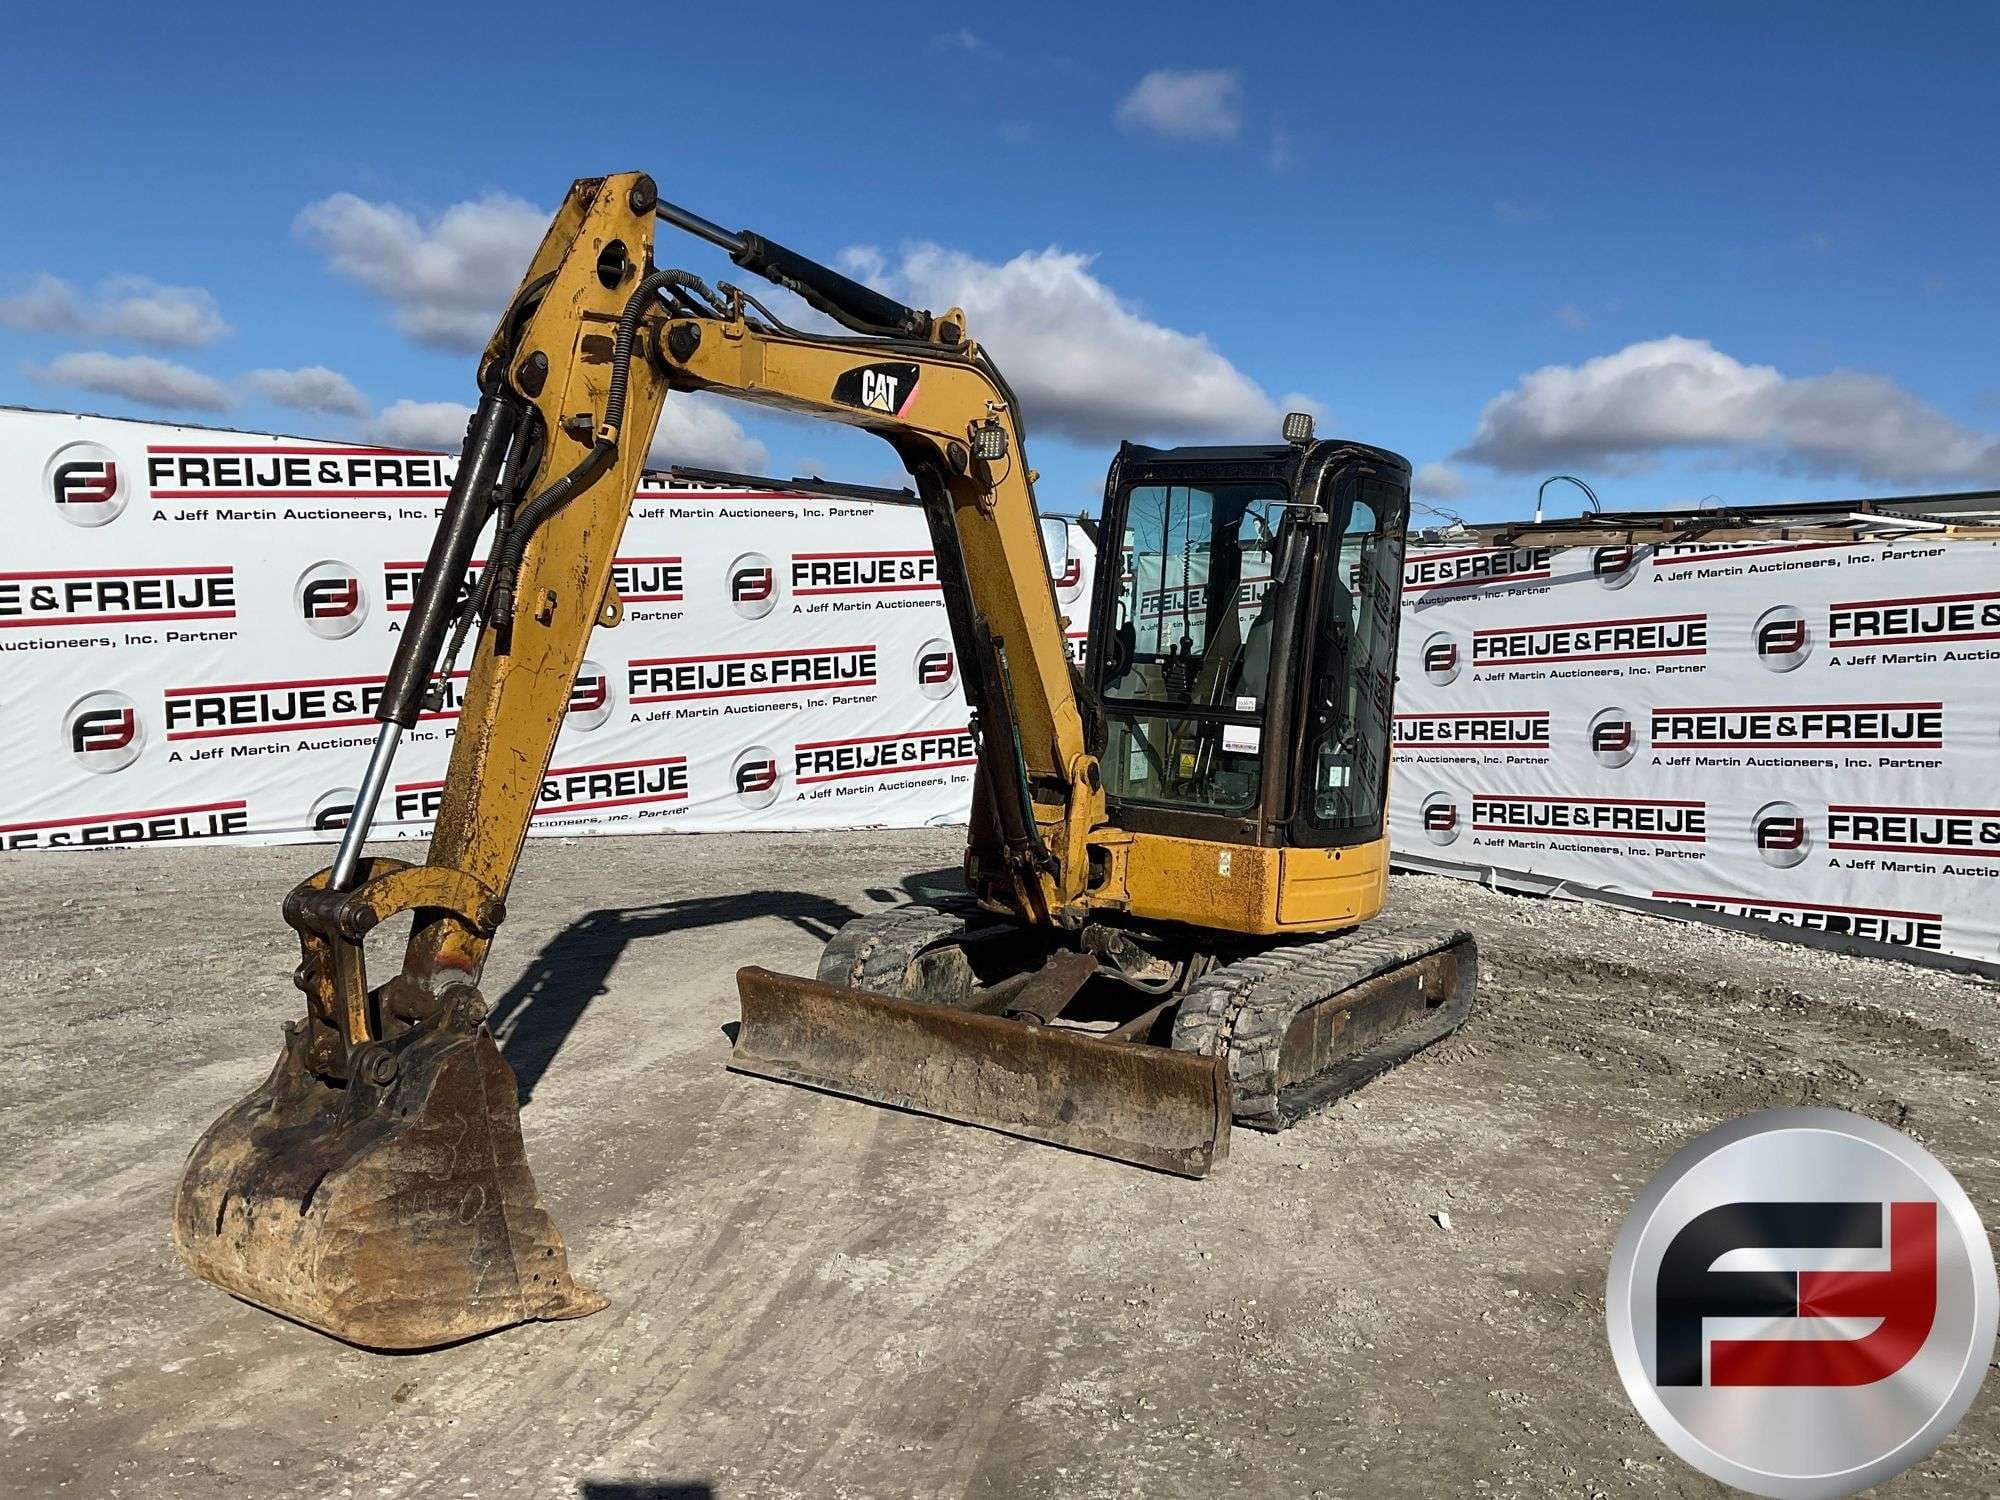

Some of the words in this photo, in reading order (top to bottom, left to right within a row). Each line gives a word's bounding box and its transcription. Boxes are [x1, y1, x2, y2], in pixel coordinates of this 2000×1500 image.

[862, 369, 898, 413] CAT
[153, 511, 167, 521] A
[175, 509, 209, 521] Jeff
[216, 509, 276, 520] Martin
[284, 508, 392, 520] Auctioneers,
[399, 508, 427, 519] Inc.
[639, 508, 665, 518] Jeff
[670, 508, 714, 518] Martin
[719, 507, 798, 519] Auctioneers,
[803, 508, 825, 517] Inc.
[830, 507, 874, 517] Partner
[1653, 574, 1663, 583] A
[1668, 571, 1693, 581] Jeff
[1697, 568, 1742, 579] Martin
[1748, 558, 1841, 573] Auctioneers,
[1848, 555, 1874, 564] Inc.
[1882, 549, 1946, 561] Partner
[1418, 593, 1481, 606] Auctioneers,
[1485, 591, 1504, 599] Inc.
[1508, 587, 1551, 597] Partner
[792, 604, 802, 613] A
[806, 603, 829, 613] Jeff
[833, 602, 871, 612] Martin
[875, 599, 945, 610] Auctioneers,
[631, 611, 684, 621] Partner
[0, 637, 117, 650] uctioneers,
[125, 634, 158, 645] Inc.
[166, 631, 238, 643] Partner
[1829, 657, 1841, 666] A
[1846, 655, 1876, 666] Jeff
[1882, 653, 1937, 664] Martin
[1473, 674, 1481, 682] A
[1485, 673, 1504, 681] Jeff
[1509, 671, 1546, 680] Martin
[1550, 668, 1623, 678] Auctioneers,
[1629, 667, 1650, 675] Inc.
[1656, 665, 1706, 674] Partner
[630, 714, 641, 722] A
[646, 711, 671, 721] Jeff
[676, 707, 719, 718] Martin
[724, 702, 802, 714] Auctioneers,
[807, 698, 828, 707] Inc.
[833, 694, 878, 704] Partner
[169, 752, 183, 762] A
[189, 747, 224, 761] Jeff
[231, 743, 290, 757] Martin
[410, 731, 438, 742] Inc.
[1416, 755, 1480, 765] Auctioneers,
[1484, 756, 1502, 764] Inc.
[1507, 756, 1550, 765] Partner
[1652, 757, 1662, 766] A
[1666, 757, 1691, 766] Jeff
[1696, 757, 1741, 767] Martin
[1746, 757, 1839, 768] Auctioneers,
[1845, 757, 1872, 767] Inc.
[1879, 758, 1943, 768] Partner
[797, 792, 806, 801] A
[810, 788, 832, 800] Jeff
[836, 785, 874, 797] Martin
[878, 777, 947, 792] Auctioneers,
[951, 774, 970, 784] Inc.
[638, 806, 689, 818] Partner
[1473, 837, 1481, 845] A
[1485, 838, 1504, 847] Jeff
[1509, 840, 1546, 849] Martin
[1550, 842, 1624, 856] Auctioneers,
[1629, 846, 1650, 856] Inc.
[1656, 848, 1706, 859] Partner
[1829, 858, 1840, 868] A
[1846, 859, 1875, 870] Jeff
[1881, 861, 1936, 874] Martin
